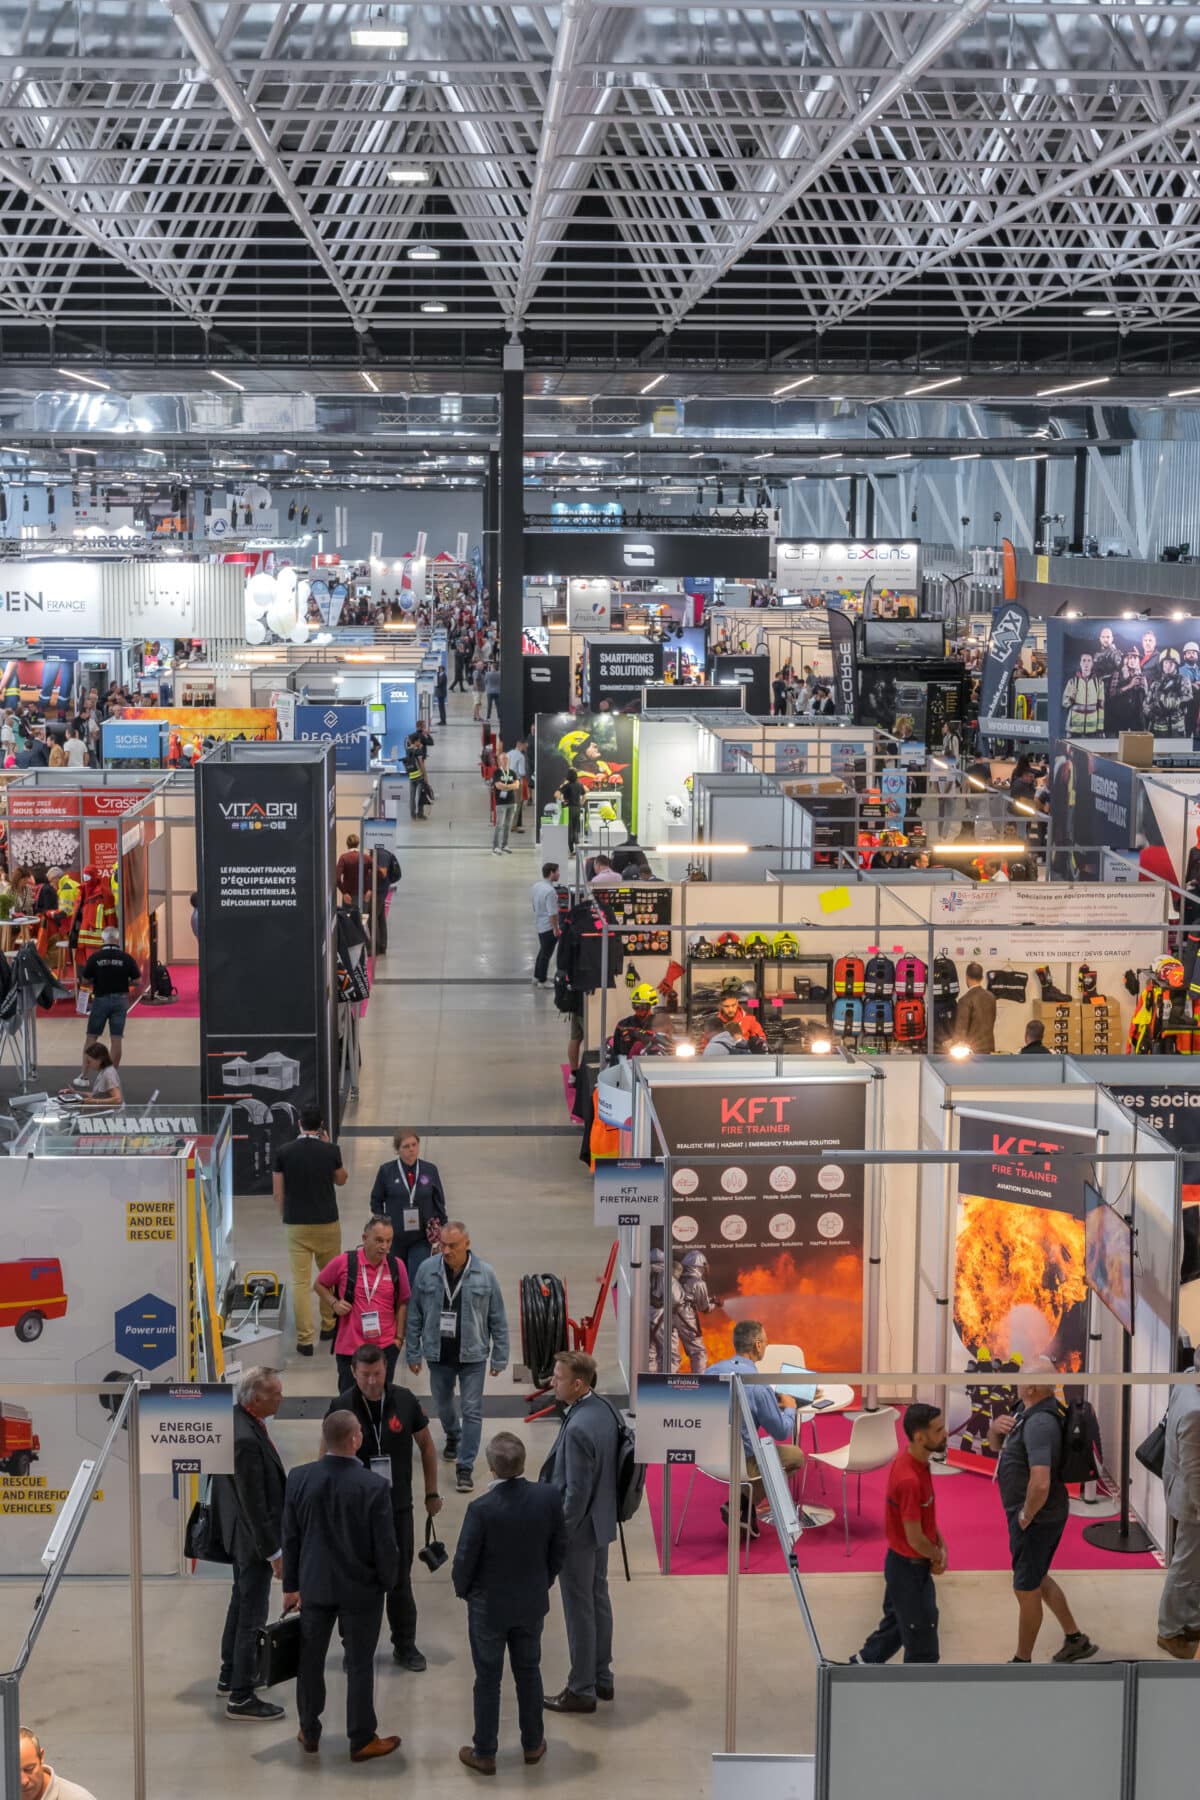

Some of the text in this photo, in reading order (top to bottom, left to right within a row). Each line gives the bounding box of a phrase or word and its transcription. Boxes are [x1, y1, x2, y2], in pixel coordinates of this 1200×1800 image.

[847, 548, 911, 560] axians
[47, 601, 86, 609] FRANCE
[600, 654, 654, 663] SMARTPHONES
[600, 665, 654, 676] & SOLUTIONS
[115, 735, 148, 744] SIOEN
[219, 803, 297, 816] VITABRI
[265, 867, 296, 875] FRANÇAIS
[220, 876, 297, 886] D'ÉQUIPEMENTS
[251, 887, 289, 895] EXTÉRIEURS
[291, 887, 297, 895] À
[1017, 892, 1052, 901] Spécialiste
[1064, 892, 1105, 900] équipements
[221, 898, 270, 906] DÉPLOIEMENT
[721, 1096, 791, 1123] KFT
[721, 1124, 791, 1135] FIRE TRAINER
[992, 1164, 1057, 1183] FIRE TRAINER
[997, 1184, 1052, 1198] AVIATION SOLUTIONS
[600, 1195, 659, 1204] FIRETRAINER
[129, 1203, 175, 1213] POWERF
[130, 1216, 175, 1226] AND REL
[620, 1216, 639, 1225] 7C19
[130, 1230, 173, 1240] RESCUE
[125, 1325, 176, 1335] Power unit
[159, 1422, 213, 1432] ENERGIE
[663, 1418, 703, 1428] MILOE
[151, 1434, 222, 1444] VAN&BOAT
[670, 1453, 692, 1461] 7C21
[175, 1462, 199, 1471] 7C22
[2, 1477, 42, 1487] RESCUE
[3, 1490, 25, 1500] AND
[3, 1504, 52, 1513] VEHICLES
